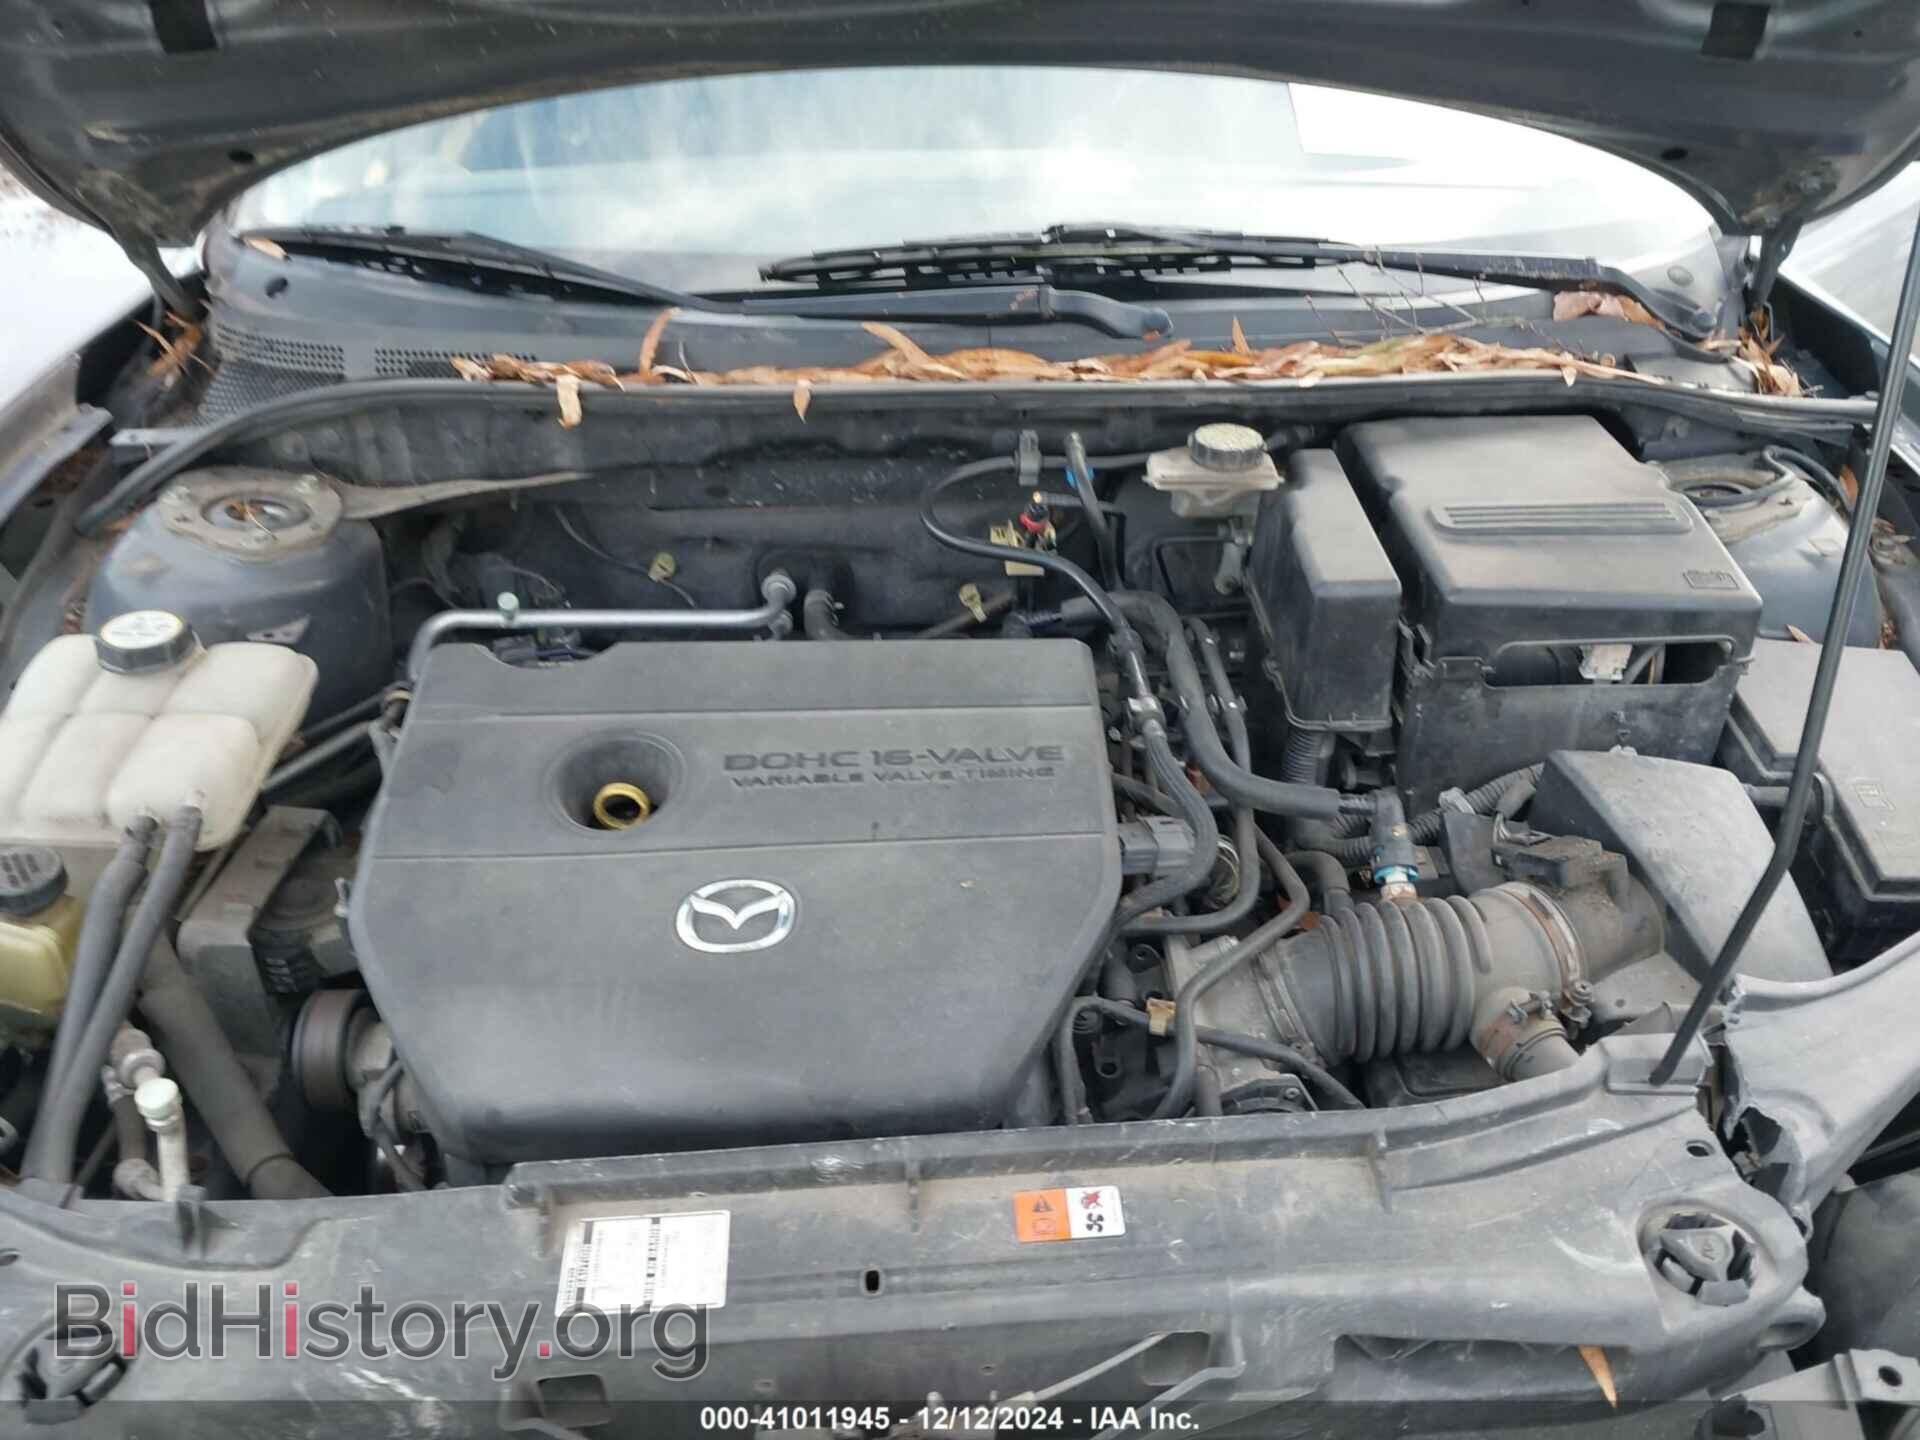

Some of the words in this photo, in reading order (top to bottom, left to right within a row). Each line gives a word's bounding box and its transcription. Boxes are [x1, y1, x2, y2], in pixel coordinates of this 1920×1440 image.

[724, 751, 861, 771] DOHC
[871, 745, 1065, 766] 16-VALVE
[731, 772, 865, 787] VARIABLE
[872, 769, 953, 783] VALVE
[964, 766, 1055, 780] TIMING
